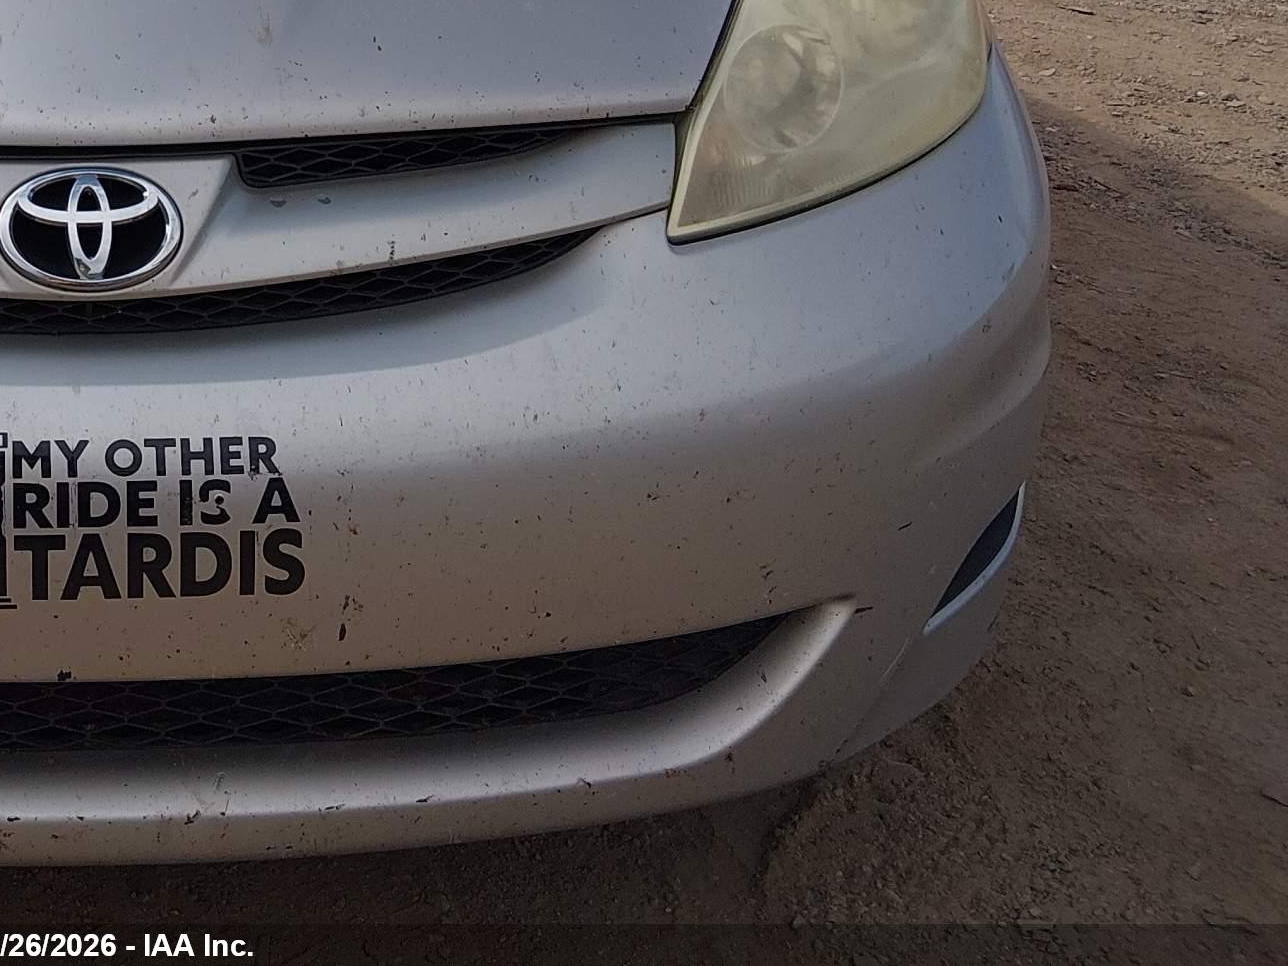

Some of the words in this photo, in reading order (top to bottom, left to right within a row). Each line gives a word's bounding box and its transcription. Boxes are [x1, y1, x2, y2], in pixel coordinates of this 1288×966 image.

[13, 439, 89, 478] MY
[105, 436, 280, 476] OTHER
[13, 480, 158, 528] RIDE
[179, 478, 232, 526] IS
[252, 477, 301, 524] A
[13, 528, 306, 600] TARDIS
